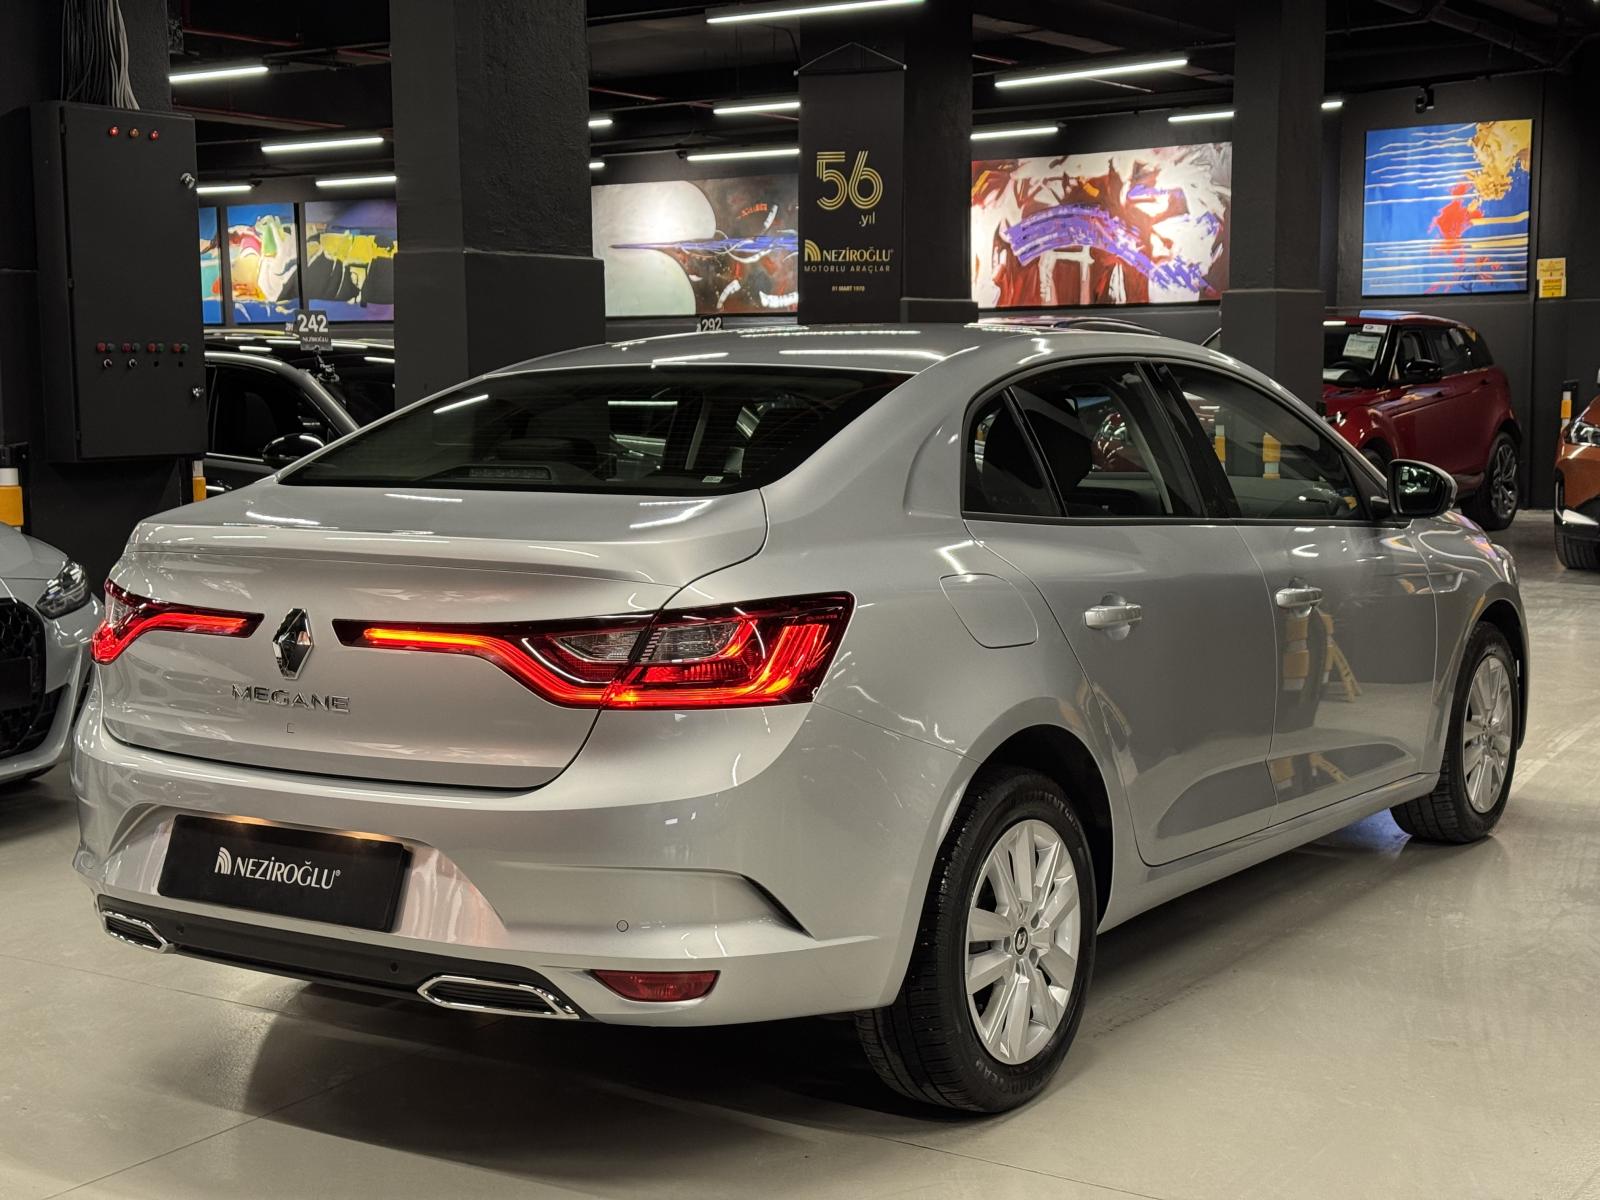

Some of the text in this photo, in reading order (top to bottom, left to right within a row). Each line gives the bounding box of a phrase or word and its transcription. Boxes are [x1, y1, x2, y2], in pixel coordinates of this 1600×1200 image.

[816, 150, 883, 211] 56
[804, 264, 891, 274] MOTORLU ARAÇLAR
[297, 313, 329, 333] 242
[702, 317, 722, 332] 292
[232, 683, 351, 713] MEGANE
